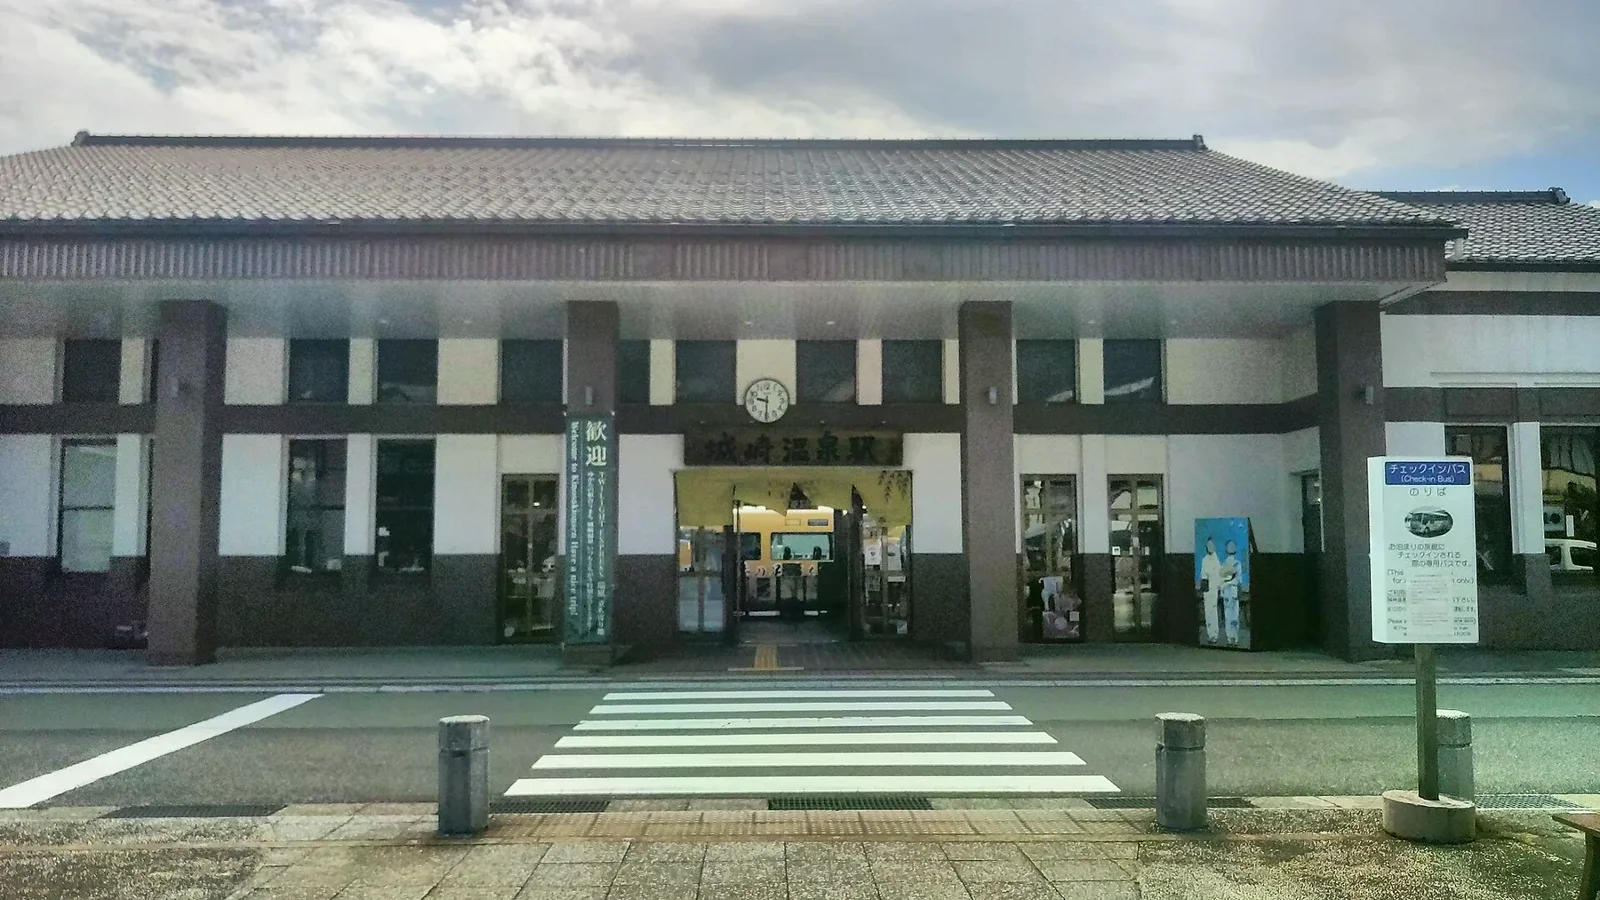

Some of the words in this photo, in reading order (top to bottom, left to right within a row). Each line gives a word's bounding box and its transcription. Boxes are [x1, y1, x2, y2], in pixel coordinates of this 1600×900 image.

[571, 421, 579, 461] Welcome
[586, 421, 607, 466] 歓迎
[703, 430, 878, 464] 城崎温泉駅
[571, 463, 578, 473] to
[1390, 464, 1466, 474] チェックインバス
[1401, 475, 1436, 483] (Check-in
[1437, 475, 1455, 483] Bus)
[1409, 487, 1447, 497] のりば
[1388, 543, 1445, 551] お泊まりの旅館に
[571, 541, 579, 564] Have
[1398, 551, 1461, 559] チェックインされる
[570, 575, 579, 594] nice
